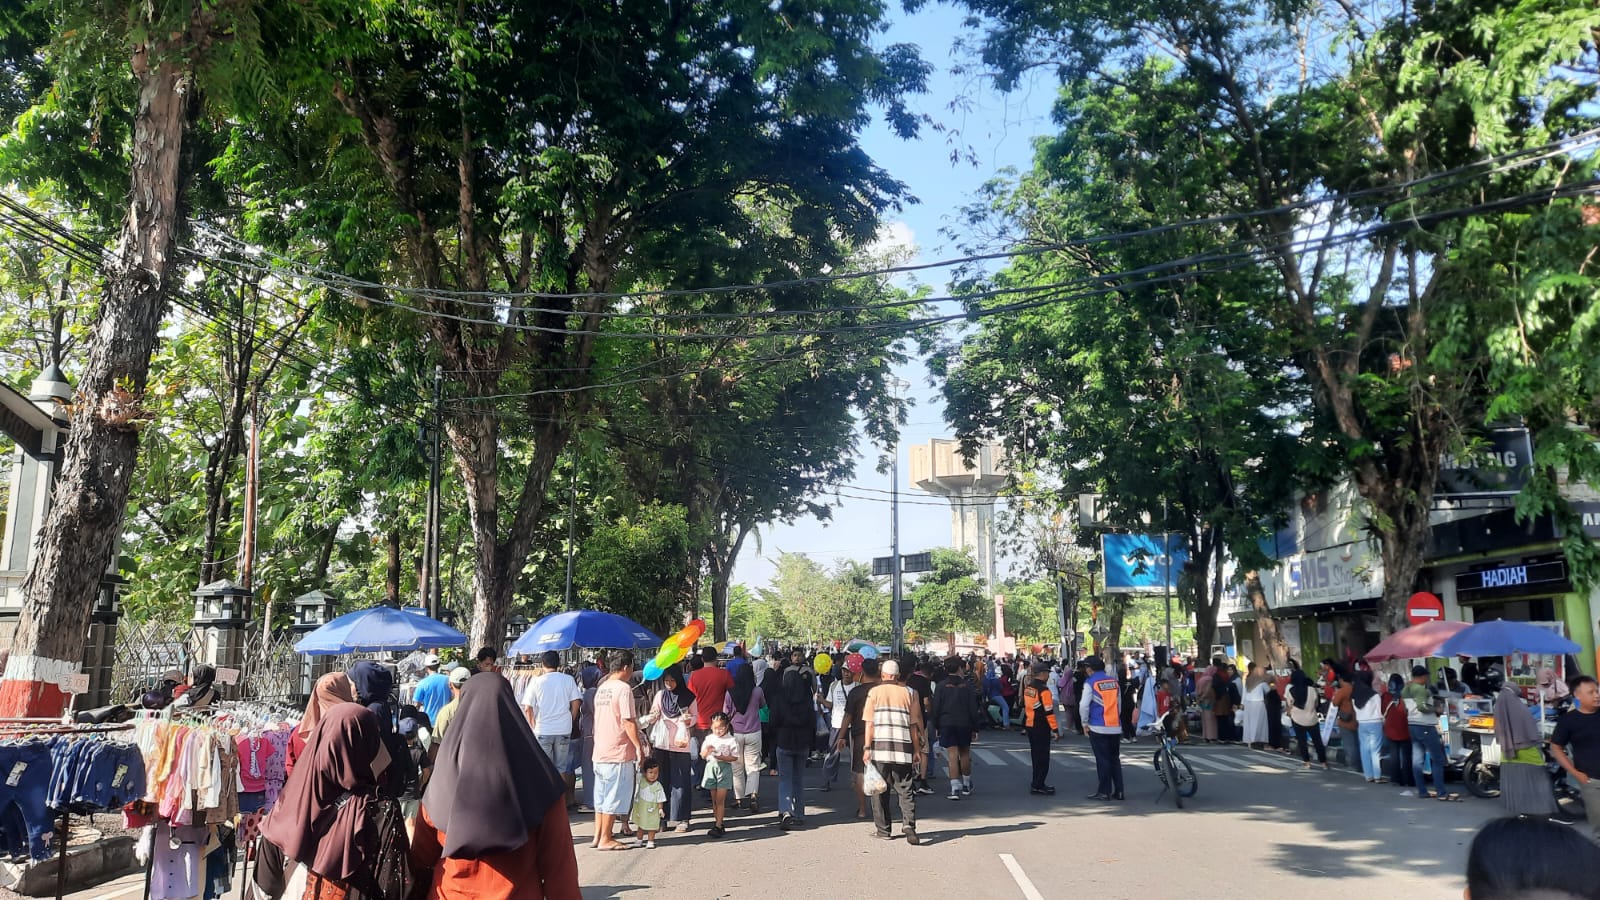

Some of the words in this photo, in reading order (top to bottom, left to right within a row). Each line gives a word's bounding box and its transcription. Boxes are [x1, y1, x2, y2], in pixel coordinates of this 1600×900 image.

[1121, 554, 1174, 566] vvo
[1289, 556, 1330, 591] SMS
[1482, 566, 1528, 588] HADIAH
